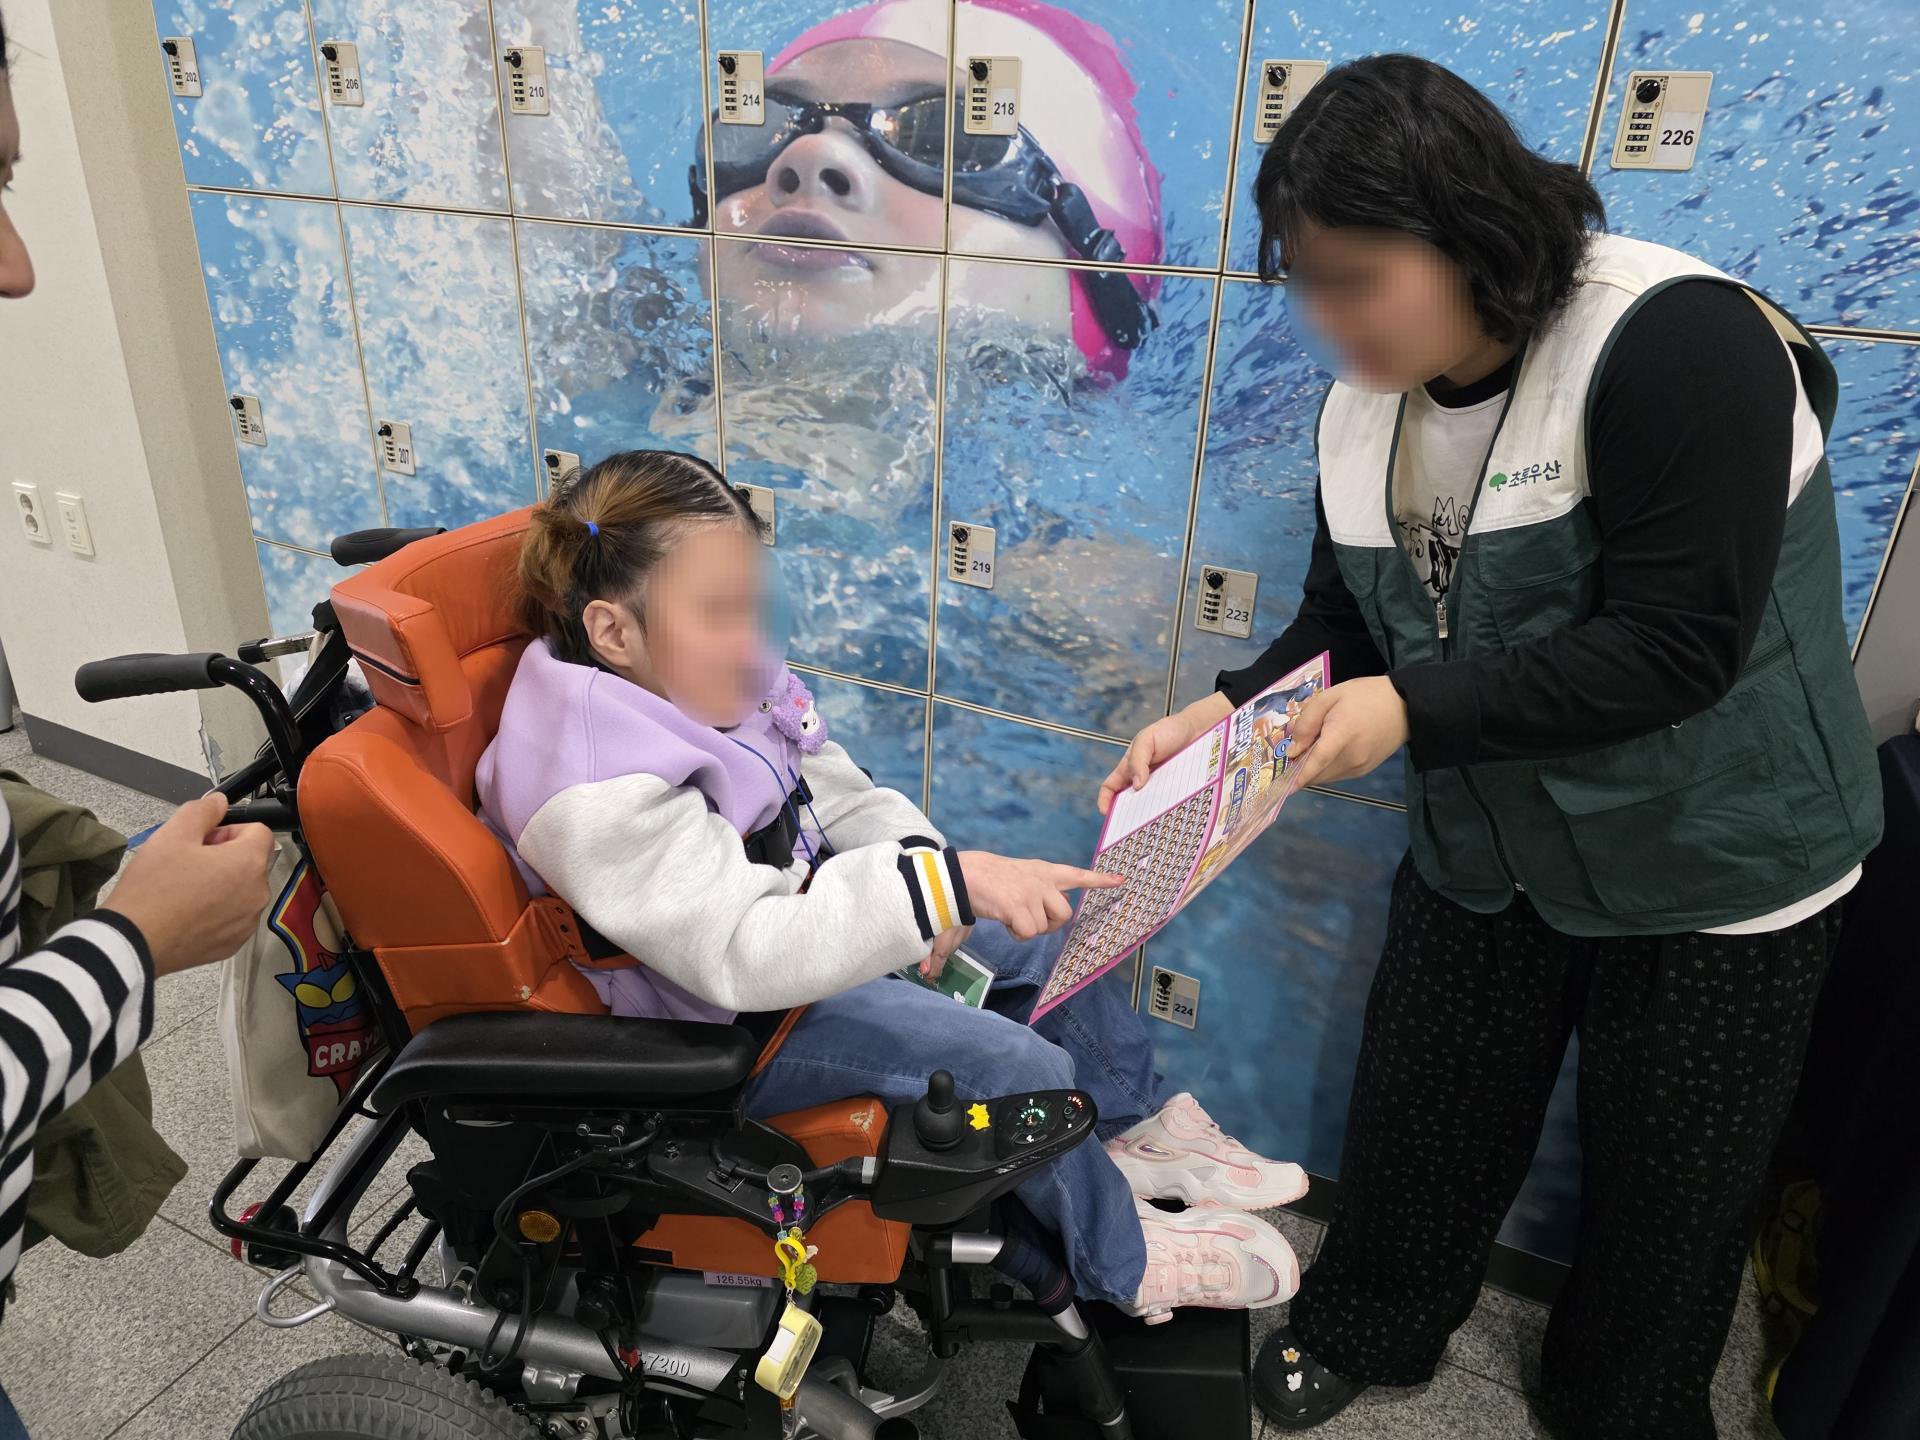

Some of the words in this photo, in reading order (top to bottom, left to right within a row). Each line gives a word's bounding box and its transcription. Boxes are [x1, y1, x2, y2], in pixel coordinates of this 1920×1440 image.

[185, 71, 197, 82] 202
[345, 78, 359, 90] 206
[528, 86, 545, 98] 210
[742, 93, 761, 107] 214
[993, 102, 1015, 116] 218
[1660, 129, 1695, 146] 226
[398, 447, 409, 465] 207
[1508, 459, 1562, 488] 초록우산
[972, 560, 991, 574] 219
[1226, 607, 1249, 623] 223
[1174, 1003, 1194, 1017] 224
[716, 1274, 762, 1287] 126.55kg
